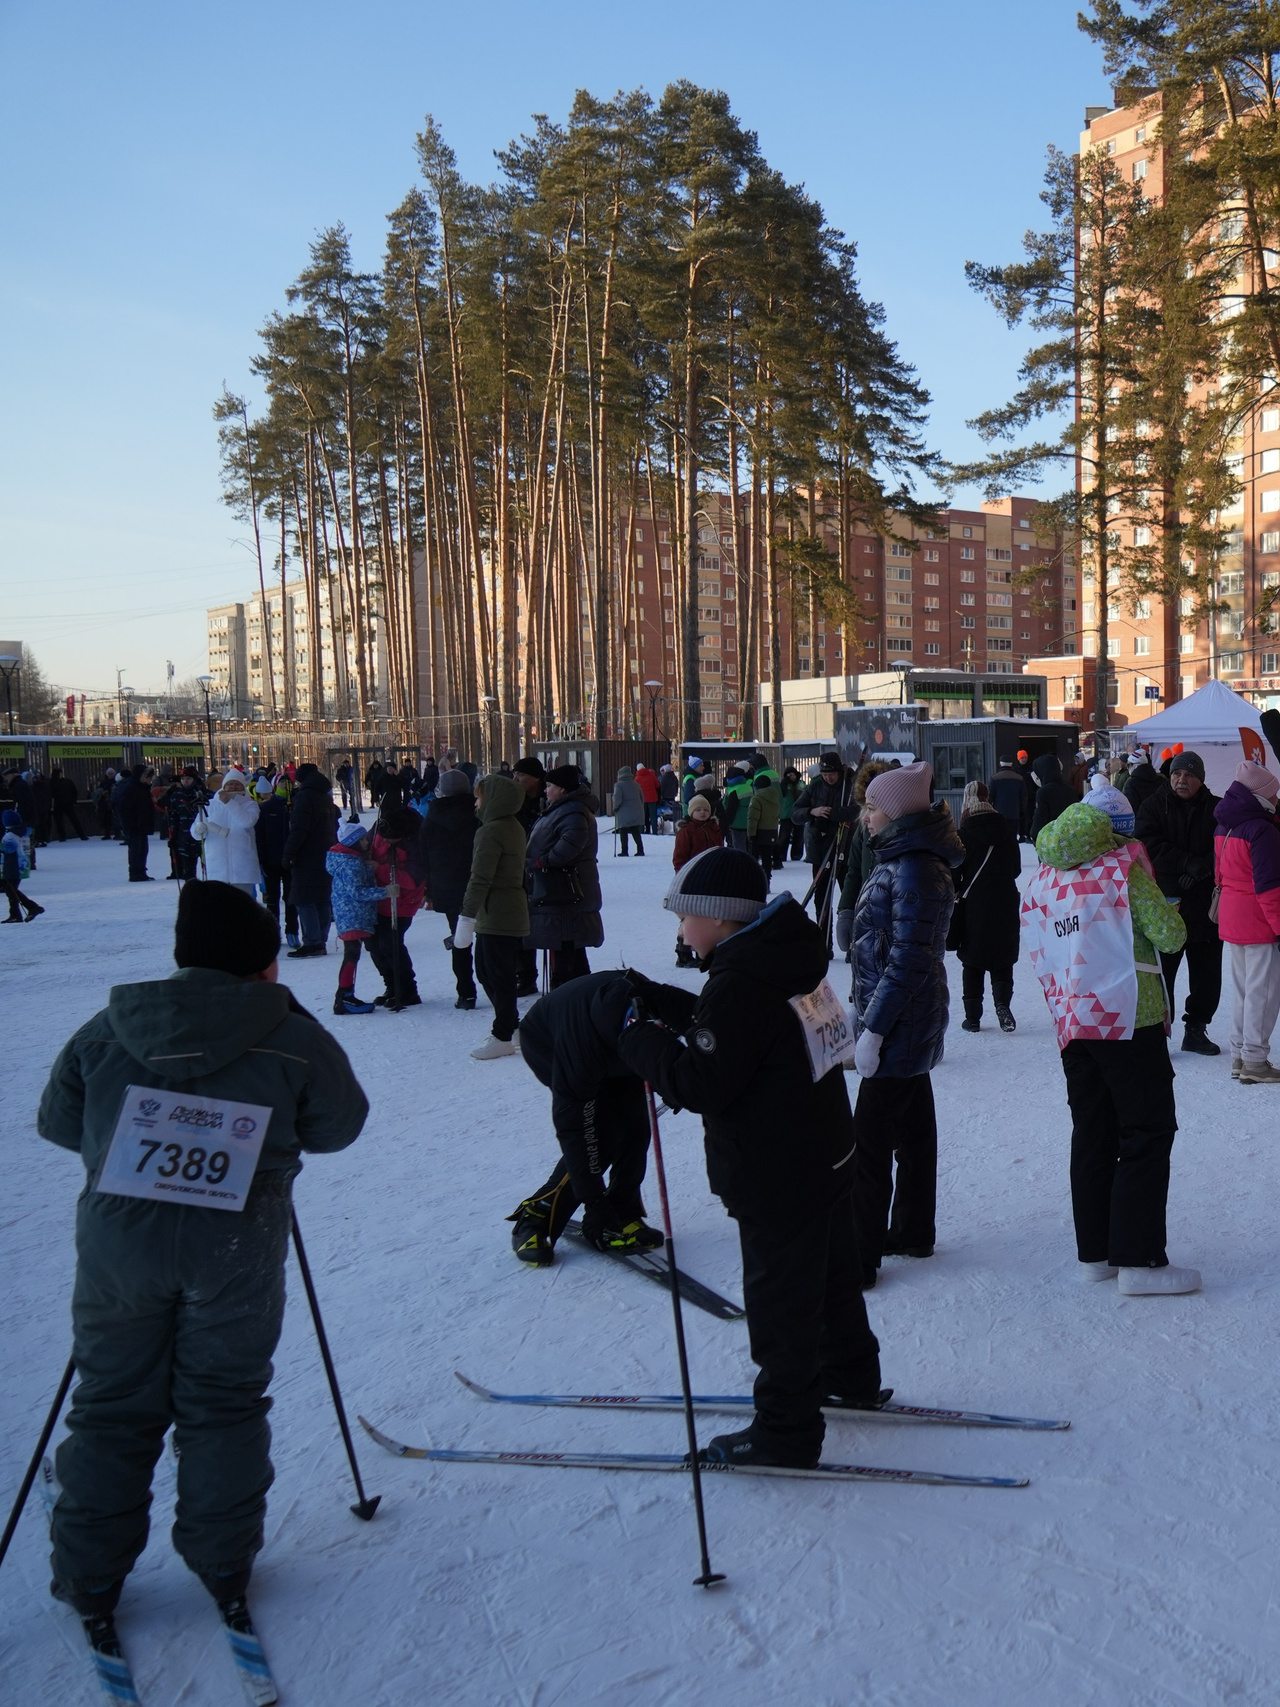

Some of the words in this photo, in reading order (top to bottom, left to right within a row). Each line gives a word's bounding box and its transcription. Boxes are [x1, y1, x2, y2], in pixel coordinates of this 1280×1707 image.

[62, 747, 111, 756] РЕГИСТРАЦИЯ
[153, 747, 194, 755] РЕГИСТРАЦИЯ
[168, 1113, 223, 1129] РОССИИ
[171, 1105, 224, 1121] ЛЫЖНЯ
[135, 1139, 230, 1185] 7389
